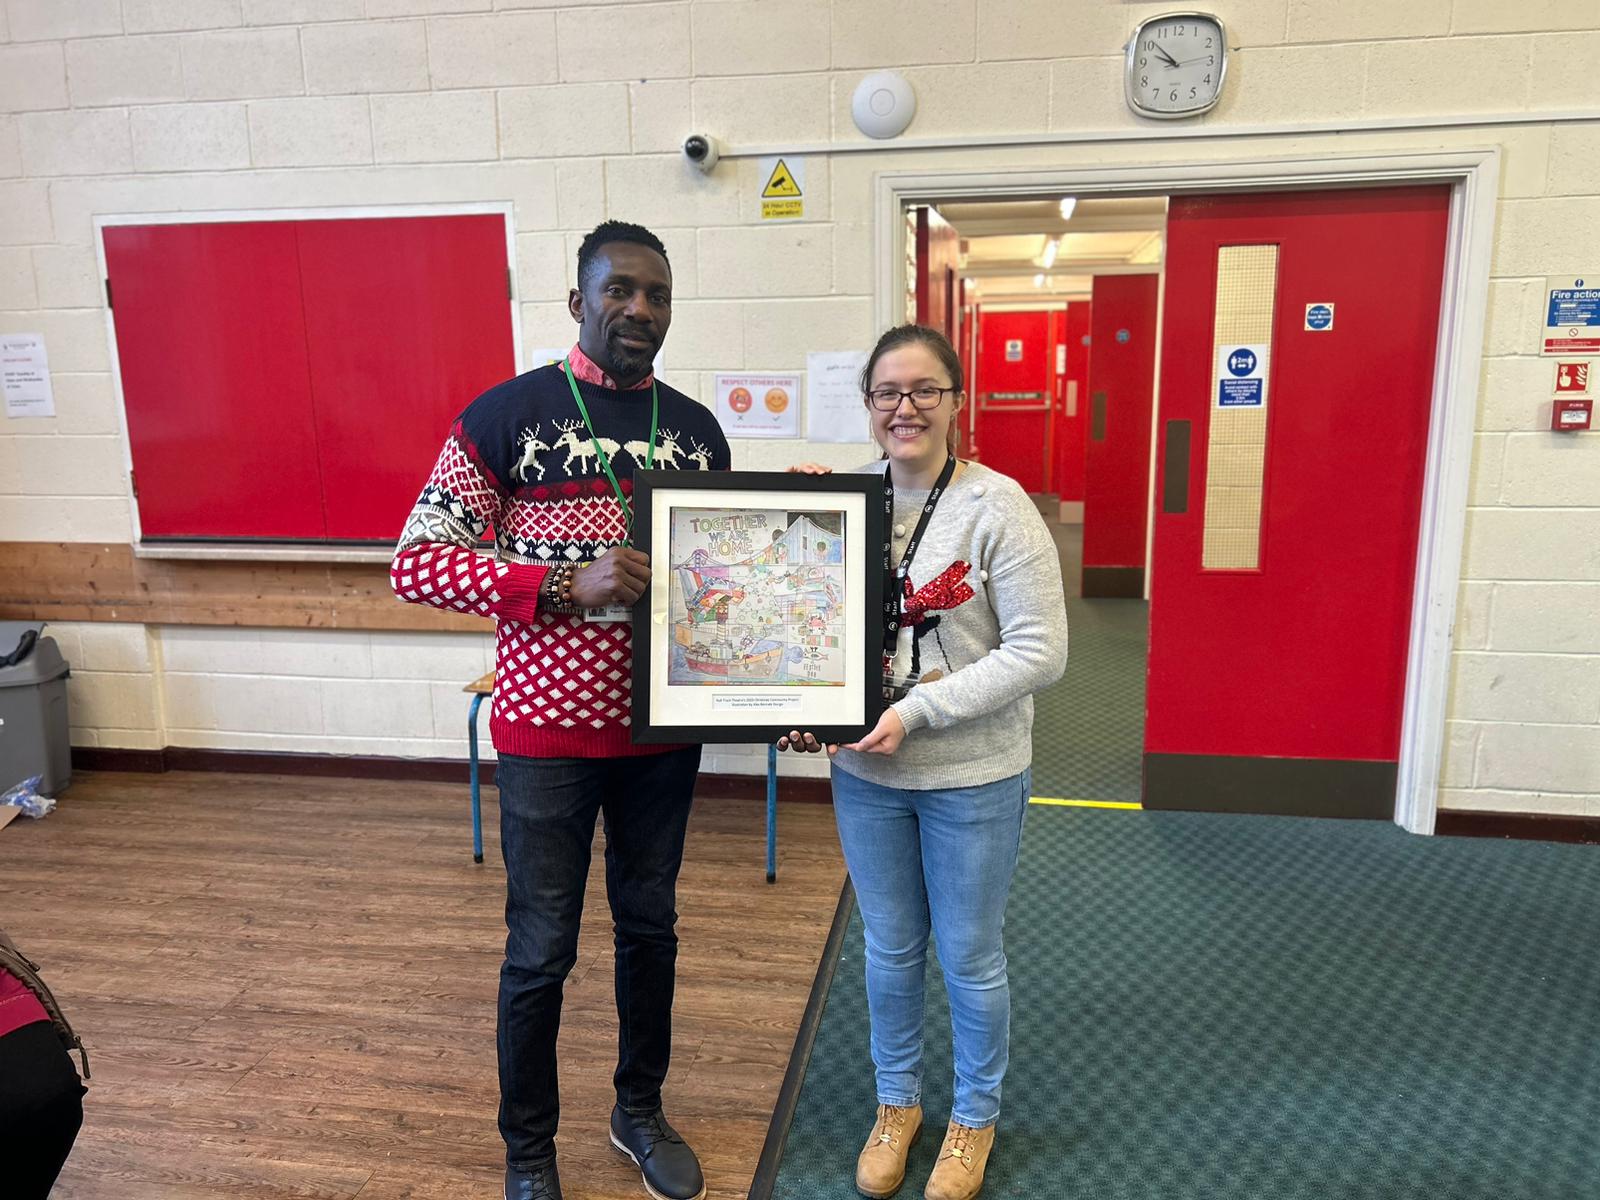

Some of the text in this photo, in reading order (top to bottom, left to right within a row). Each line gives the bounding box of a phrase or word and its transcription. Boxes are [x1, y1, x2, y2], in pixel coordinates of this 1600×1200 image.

[1158, 28, 1168, 38] 11
[1173, 26, 1184, 36] 12
[1143, 40, 1155, 51] 10
[1204, 38, 1212, 48] 2
[1140, 58, 1147, 69] 9
[1206, 55, 1214, 66] 3
[1140, 76, 1148, 88] 8
[1203, 74, 1210, 85] 4
[1152, 88, 1160, 100] 7
[1170, 89, 1178, 102] 6
[1189, 87, 1196, 99] 5
[1552, 290, 1571, 298] Fire
[690, 513, 768, 533] TOGETHER
[708, 529, 750, 542] WE ARE
[708, 540, 753, 557] HOME
